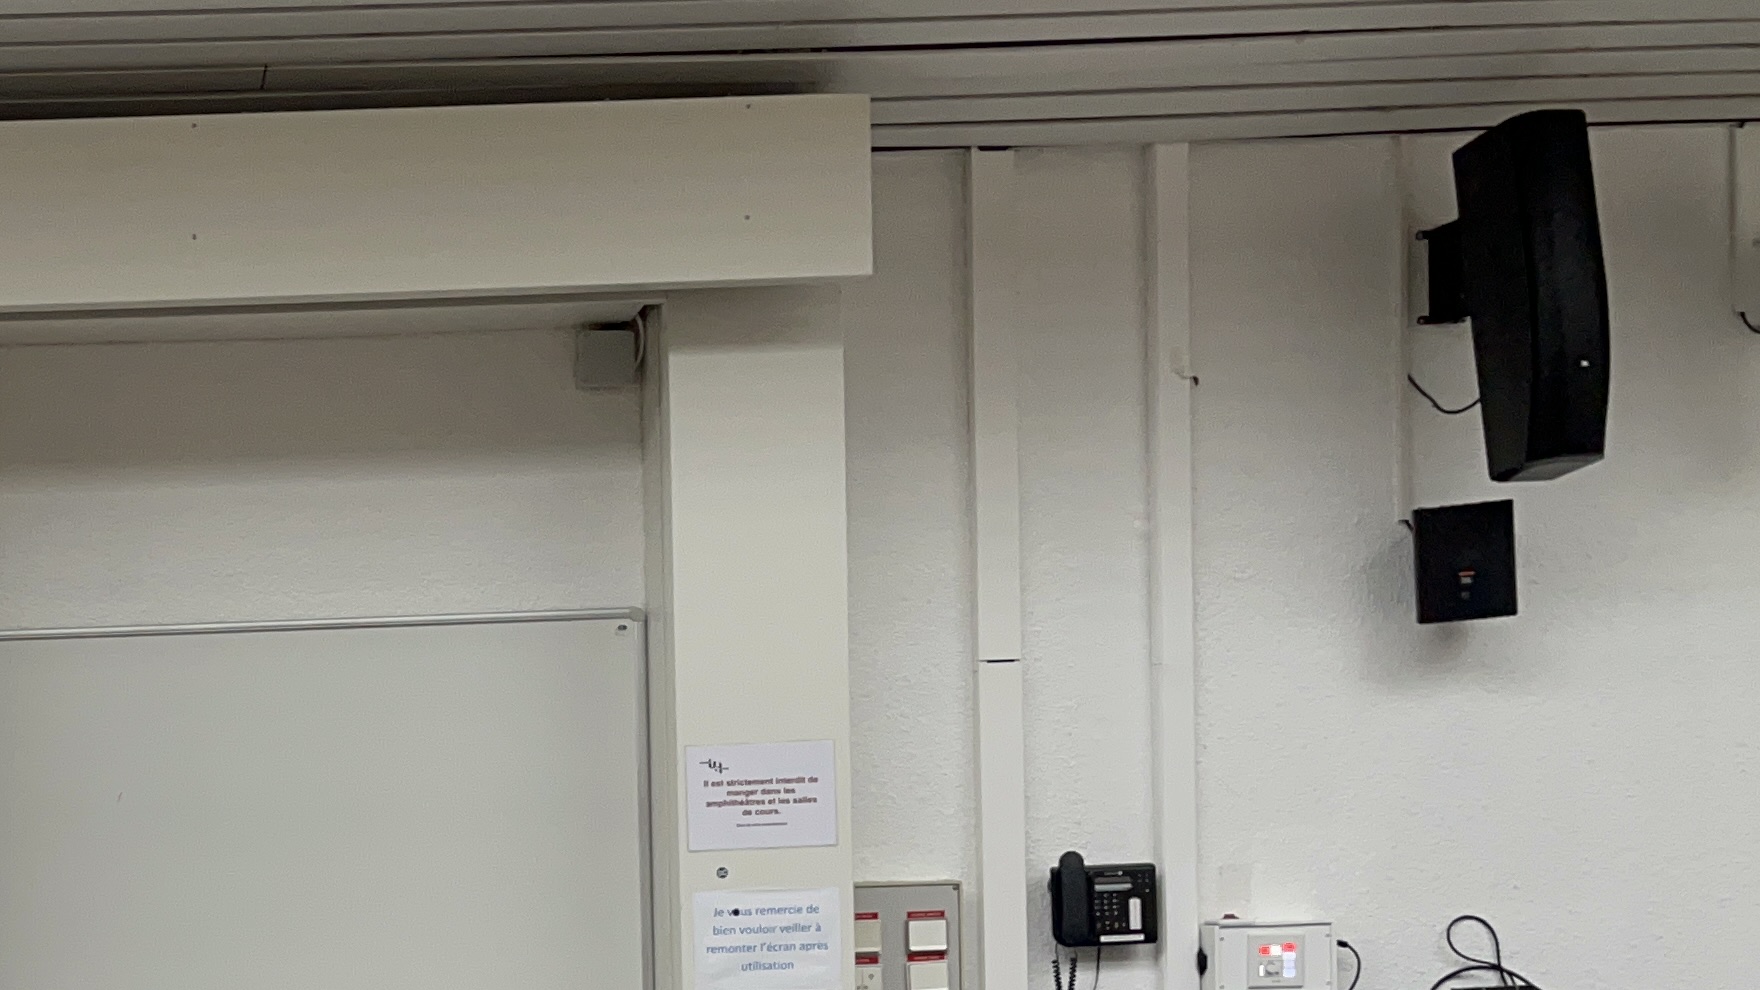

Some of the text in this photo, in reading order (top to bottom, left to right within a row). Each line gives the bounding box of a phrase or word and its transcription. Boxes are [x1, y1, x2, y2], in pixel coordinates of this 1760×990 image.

[726, 778, 773, 787] strictement
[726, 788, 758, 797] manger
[760, 788, 781, 796] dans
[793, 796, 817, 804] salles
[713, 904, 819, 918] Je vus remercie de
[713, 922, 821, 936] bien vouloir veiller à
[706, 944, 757, 954] remonter
[799, 942, 828, 953] après
[741, 960, 794, 971] utilisation
